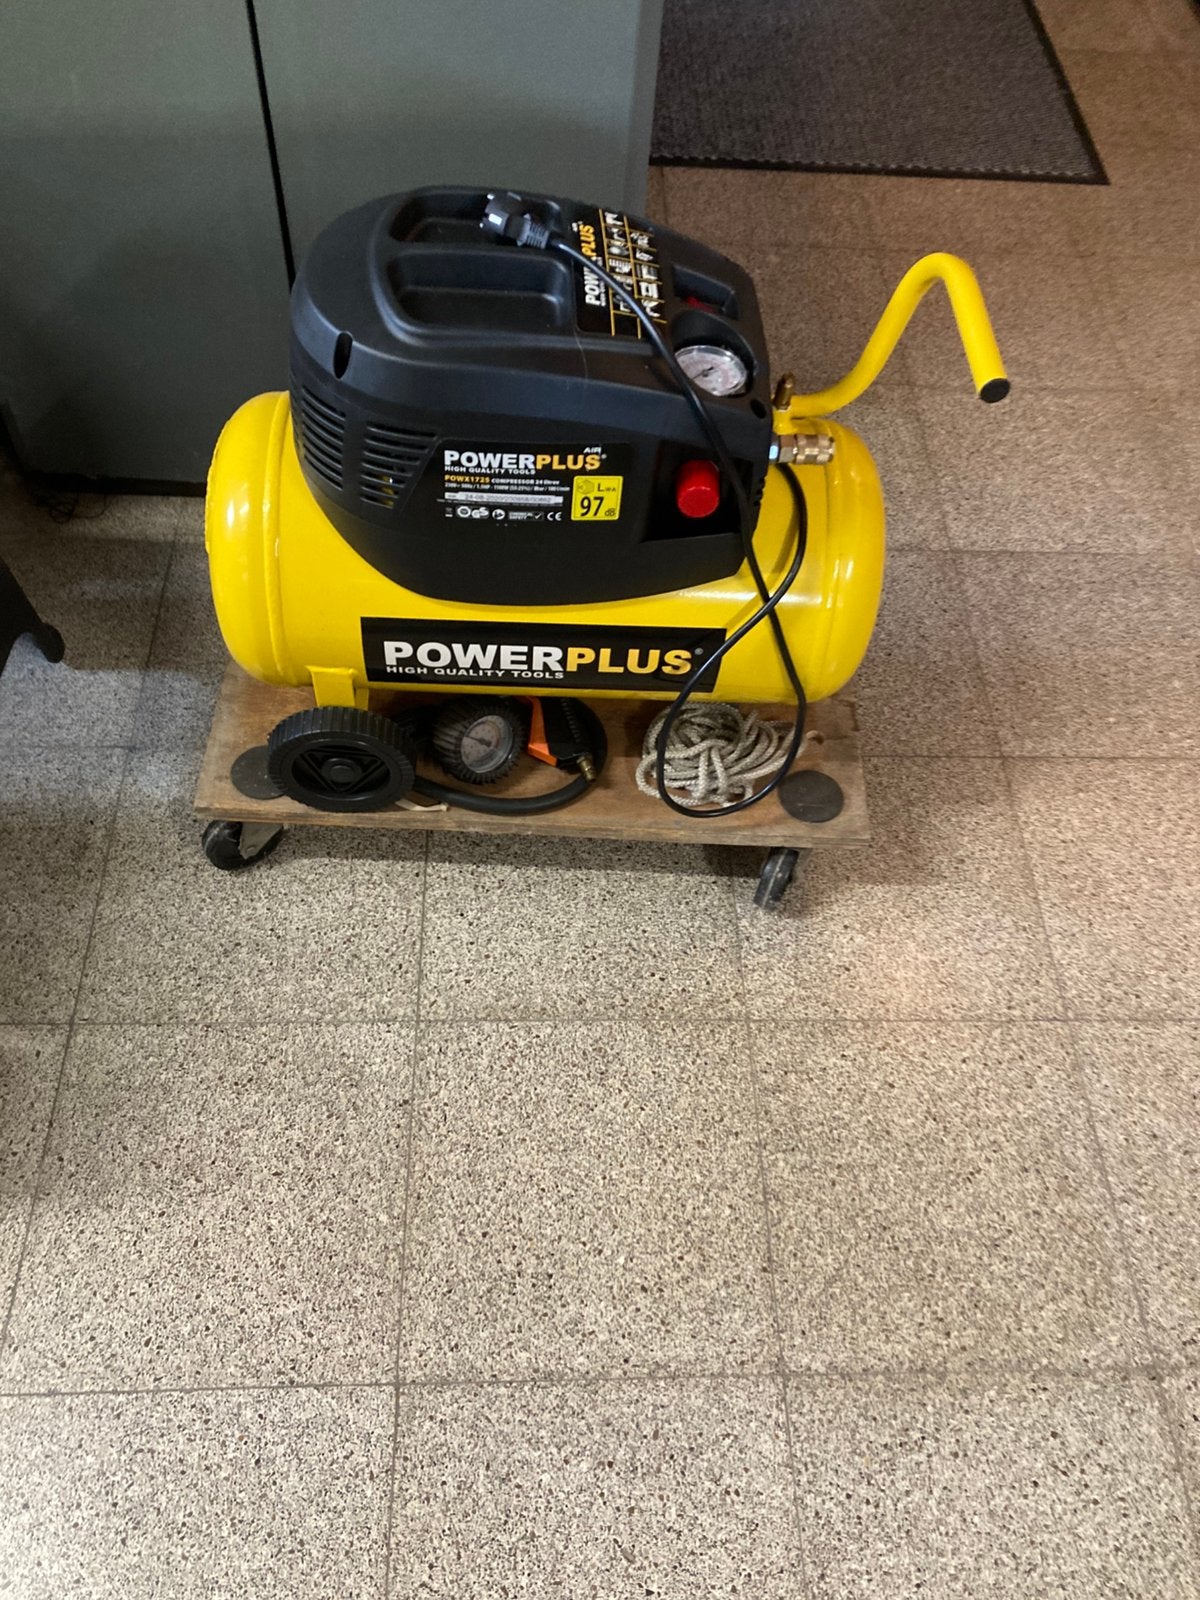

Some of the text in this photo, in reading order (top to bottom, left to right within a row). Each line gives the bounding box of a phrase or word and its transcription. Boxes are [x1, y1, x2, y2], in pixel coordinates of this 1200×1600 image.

[579, 224, 602, 306] POWPLUS
[583, 446, 602, 454] AIR
[444, 449, 601, 470] POWERPLUS
[444, 465, 466, 473] HIGH
[444, 474, 490, 483] POWX1725
[580, 495, 604, 517] 97
[383, 640, 692, 675] POWERPLUS
[386, 666, 564, 679] HIGH QUALITY TOOLS
